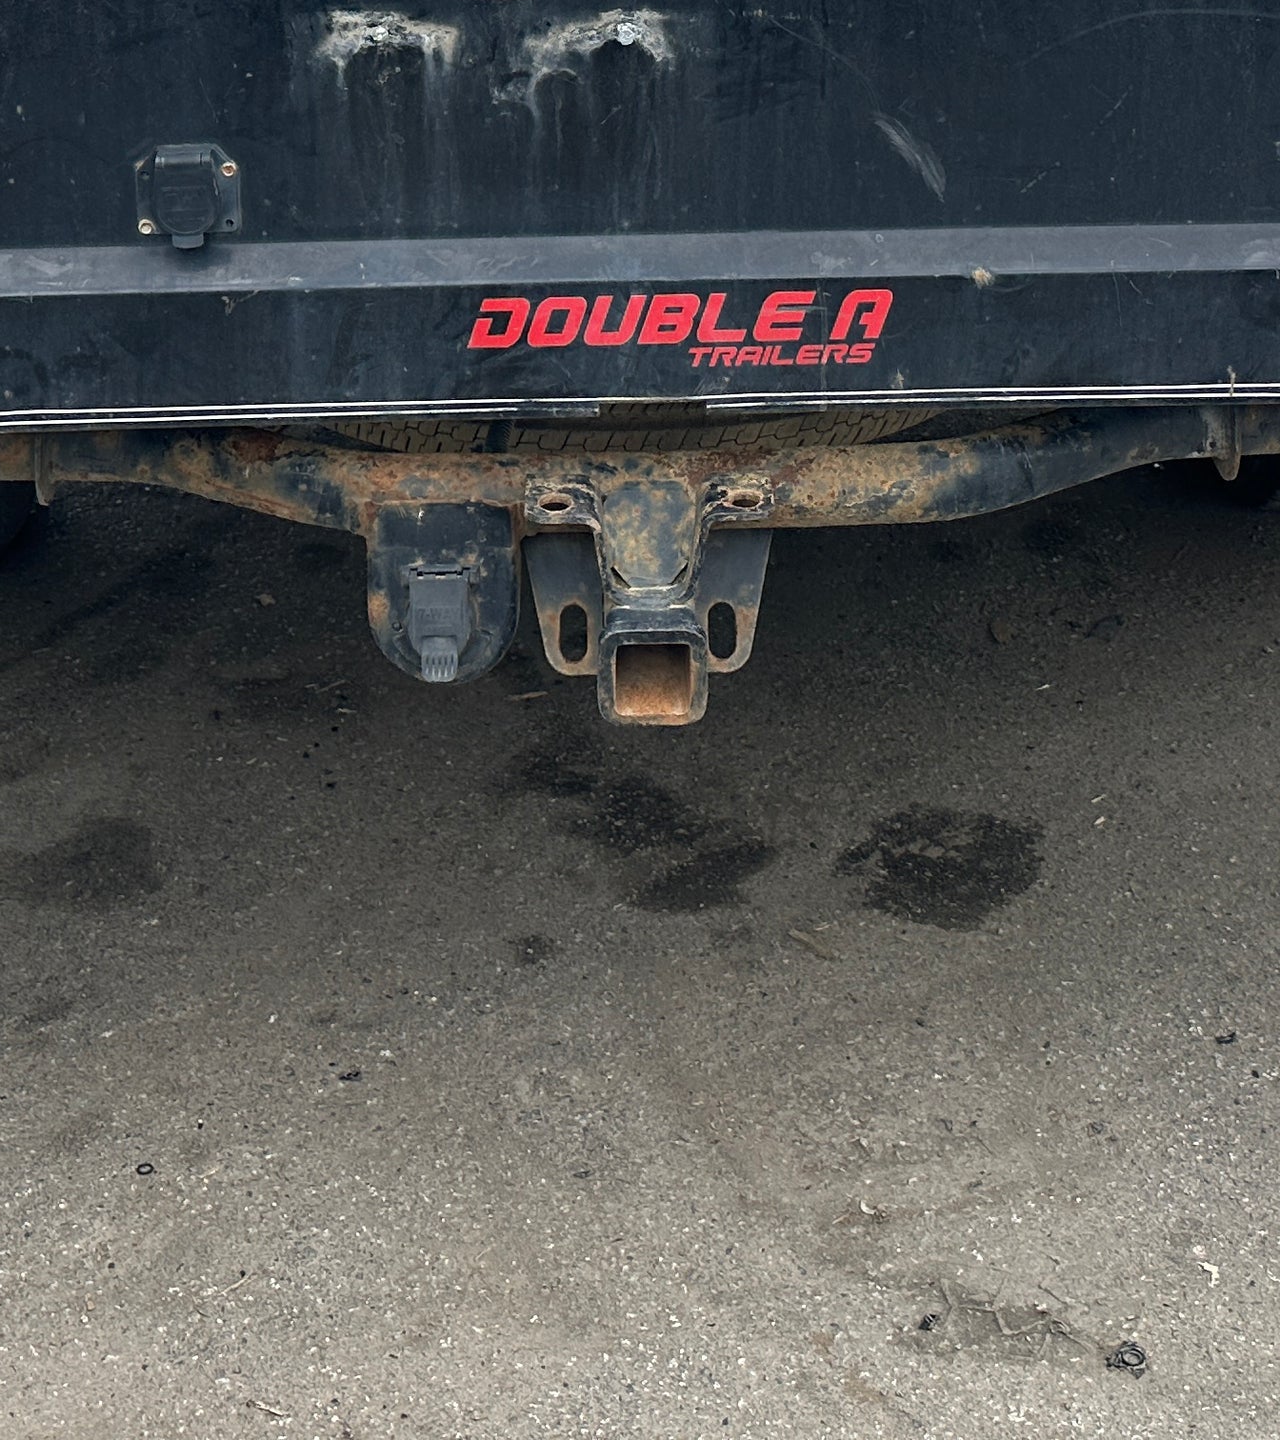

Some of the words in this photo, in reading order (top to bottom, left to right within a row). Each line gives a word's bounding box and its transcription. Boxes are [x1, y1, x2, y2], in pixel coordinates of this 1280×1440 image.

[467, 289, 817, 350] DOUBLE
[829, 288, 894, 340] A
[687, 341, 876, 368] TRAILERS
